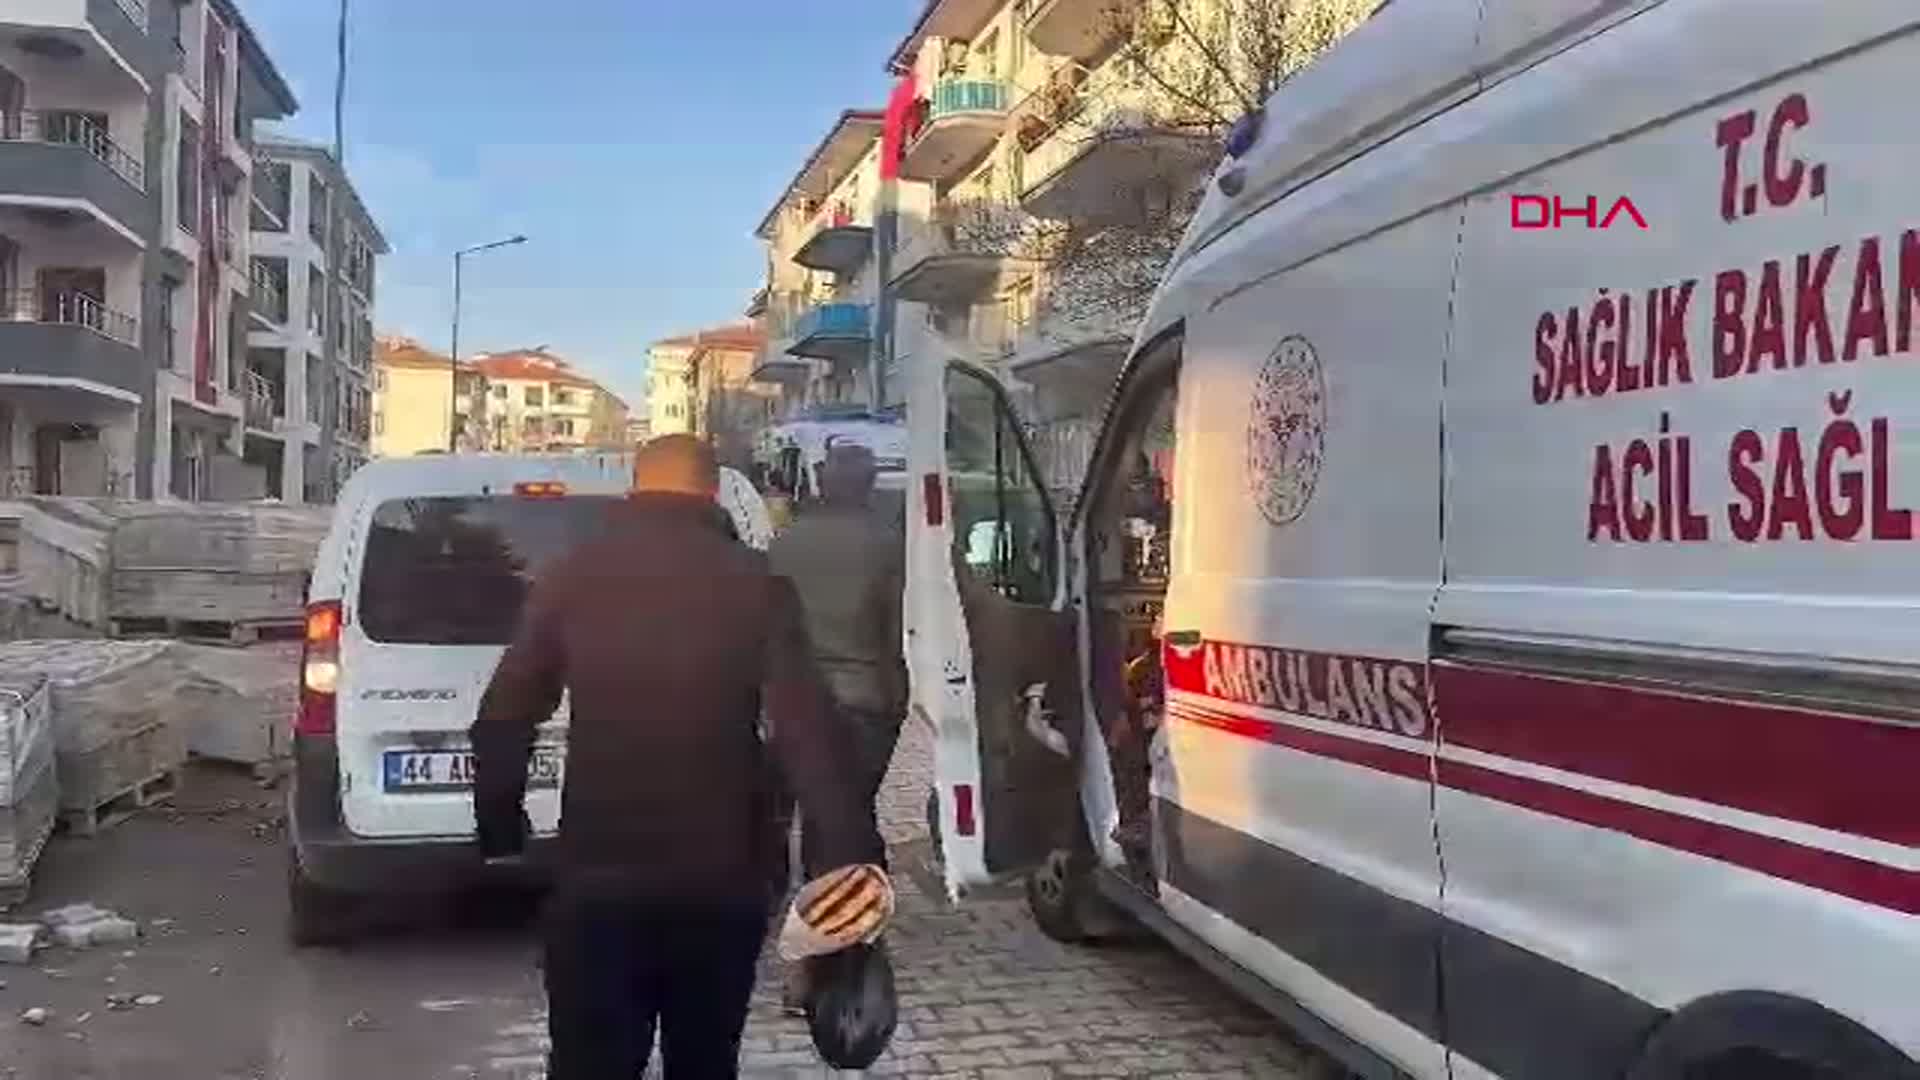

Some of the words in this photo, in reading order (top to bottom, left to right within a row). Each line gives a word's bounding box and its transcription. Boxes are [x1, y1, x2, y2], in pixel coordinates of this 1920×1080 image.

[1716, 93, 1826, 223] T.C.
[1532, 279, 1697, 405] SAĞLIK
[1587, 412, 1710, 541] ACİL
[1204, 645, 1428, 736] AMBULANS
[404, 756, 431, 781] 44
